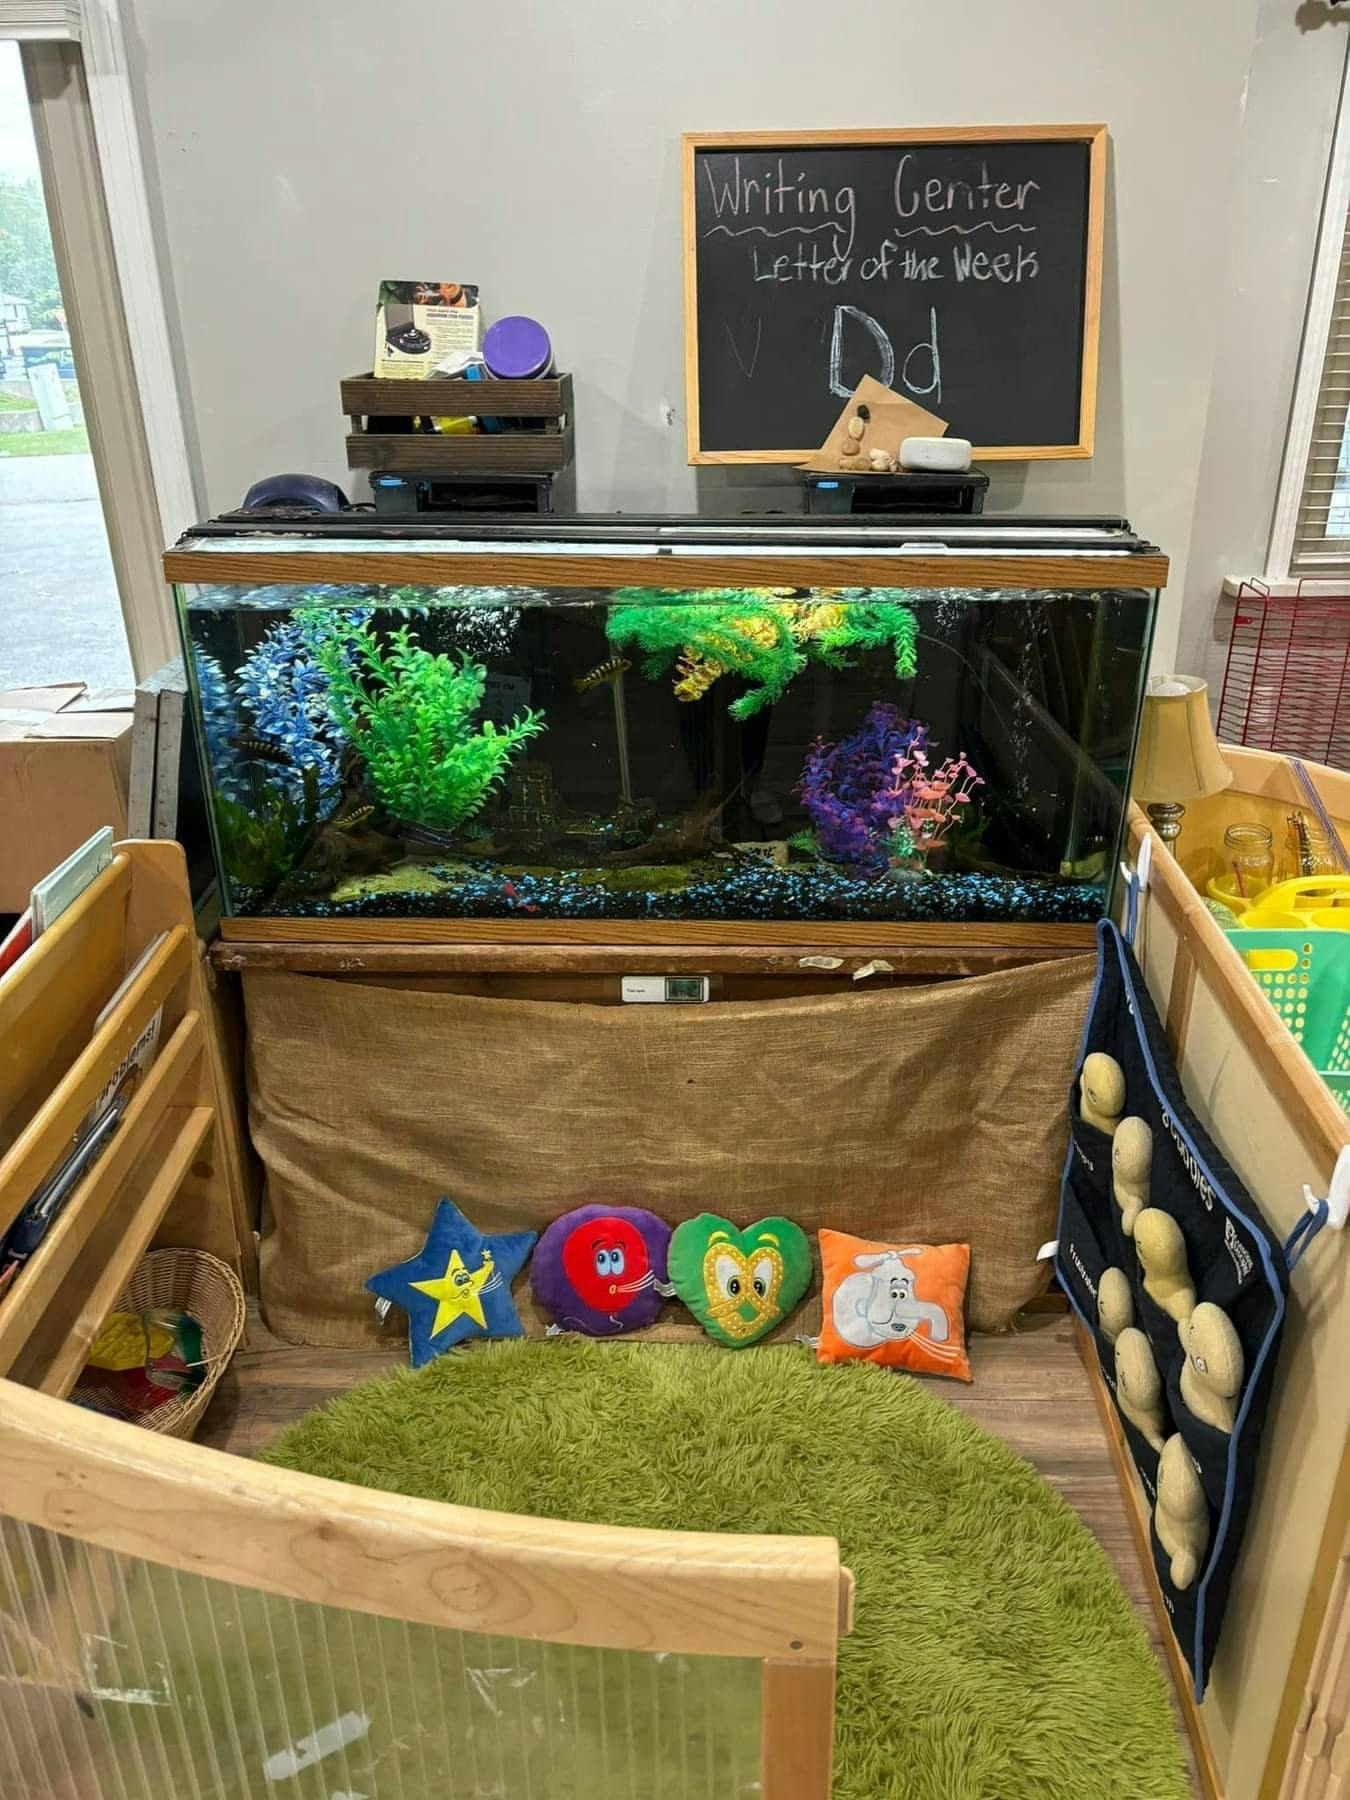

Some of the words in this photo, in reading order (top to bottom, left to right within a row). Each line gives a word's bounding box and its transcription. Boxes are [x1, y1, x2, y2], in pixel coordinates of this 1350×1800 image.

[703, 156, 855, 262] Writing
[895, 154, 1040, 217] Center
[754, 243, 853, 284] Letter
[860, 239, 899, 281] of
[899, 243, 944, 281] the
[953, 242, 1039, 282] Week
